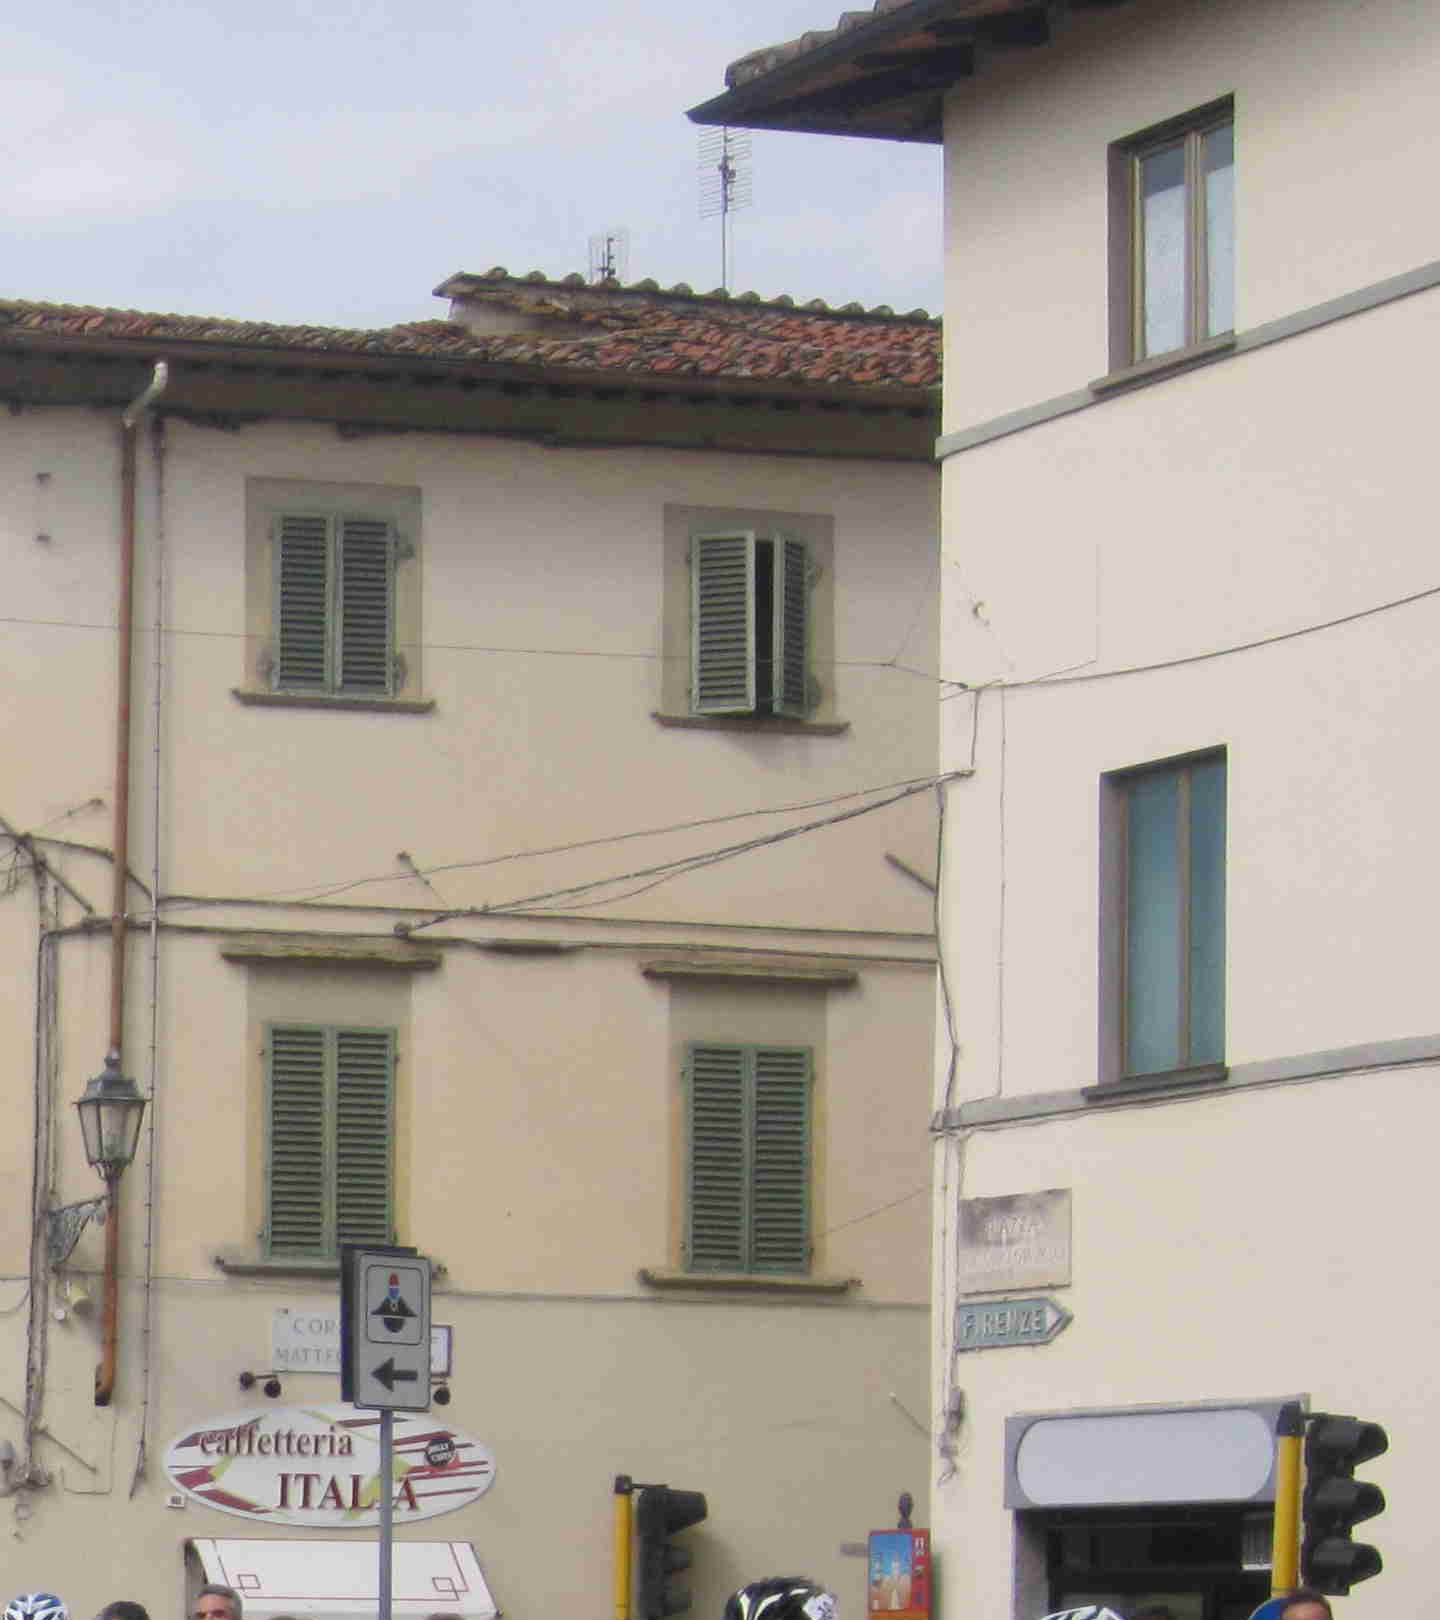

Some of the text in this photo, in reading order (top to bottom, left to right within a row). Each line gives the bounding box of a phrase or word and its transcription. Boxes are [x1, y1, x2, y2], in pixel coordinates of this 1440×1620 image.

[965, 1308, 1042, 1340] FIRENZE
[199, 1424, 355, 1459] caffetteria
[276, 1472, 421, 1512] ITALA
